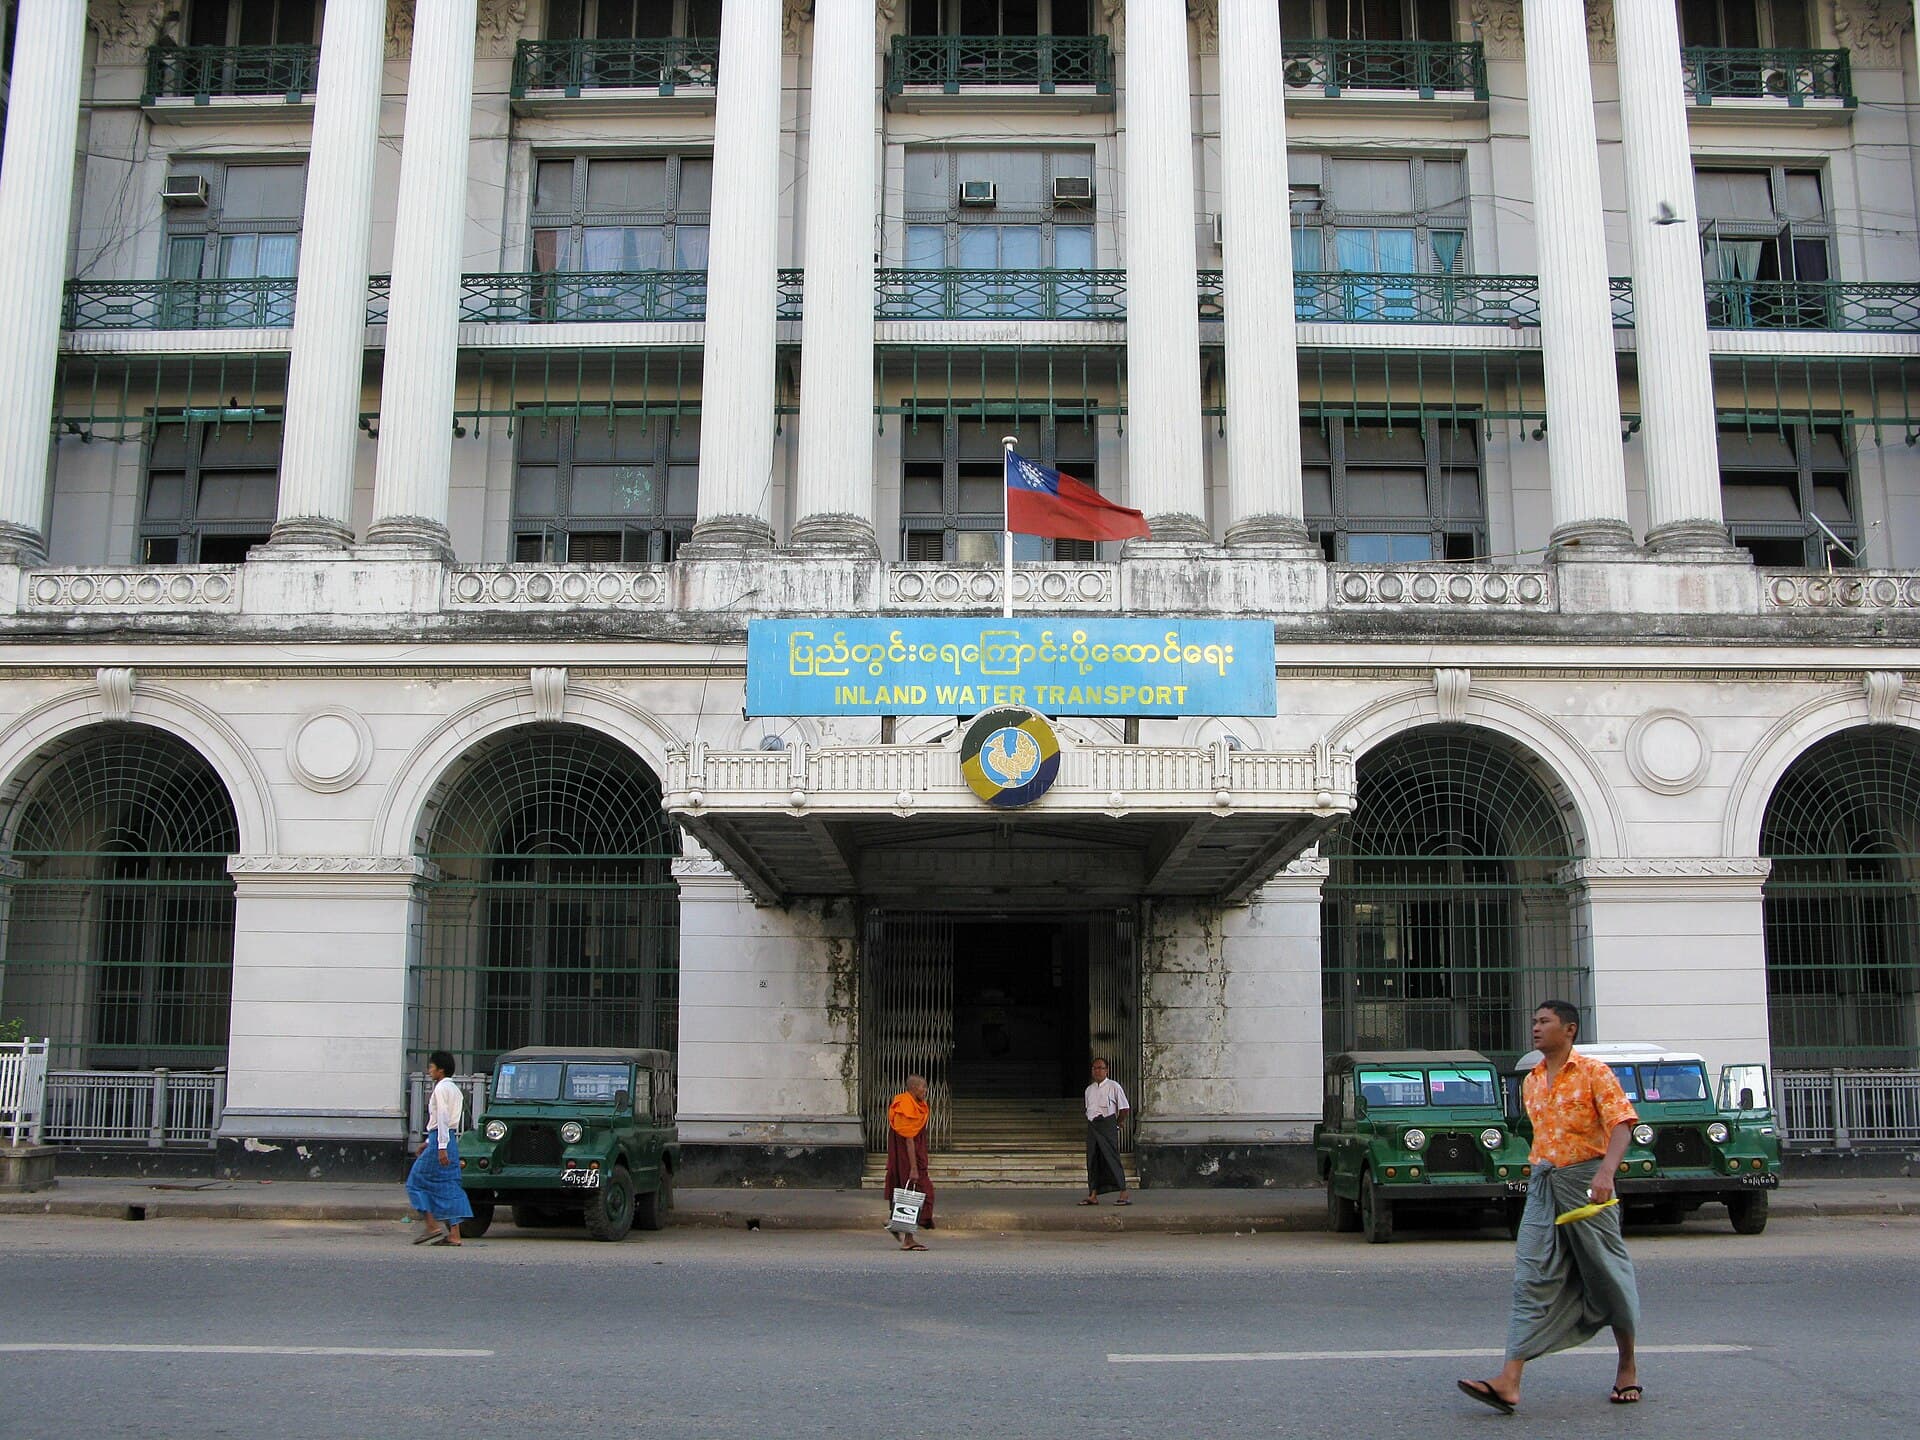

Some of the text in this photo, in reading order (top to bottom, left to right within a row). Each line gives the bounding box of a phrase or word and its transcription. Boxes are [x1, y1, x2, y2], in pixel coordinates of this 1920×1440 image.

[835, 685, 1188, 705] INLAND WATER TRANSPORT
